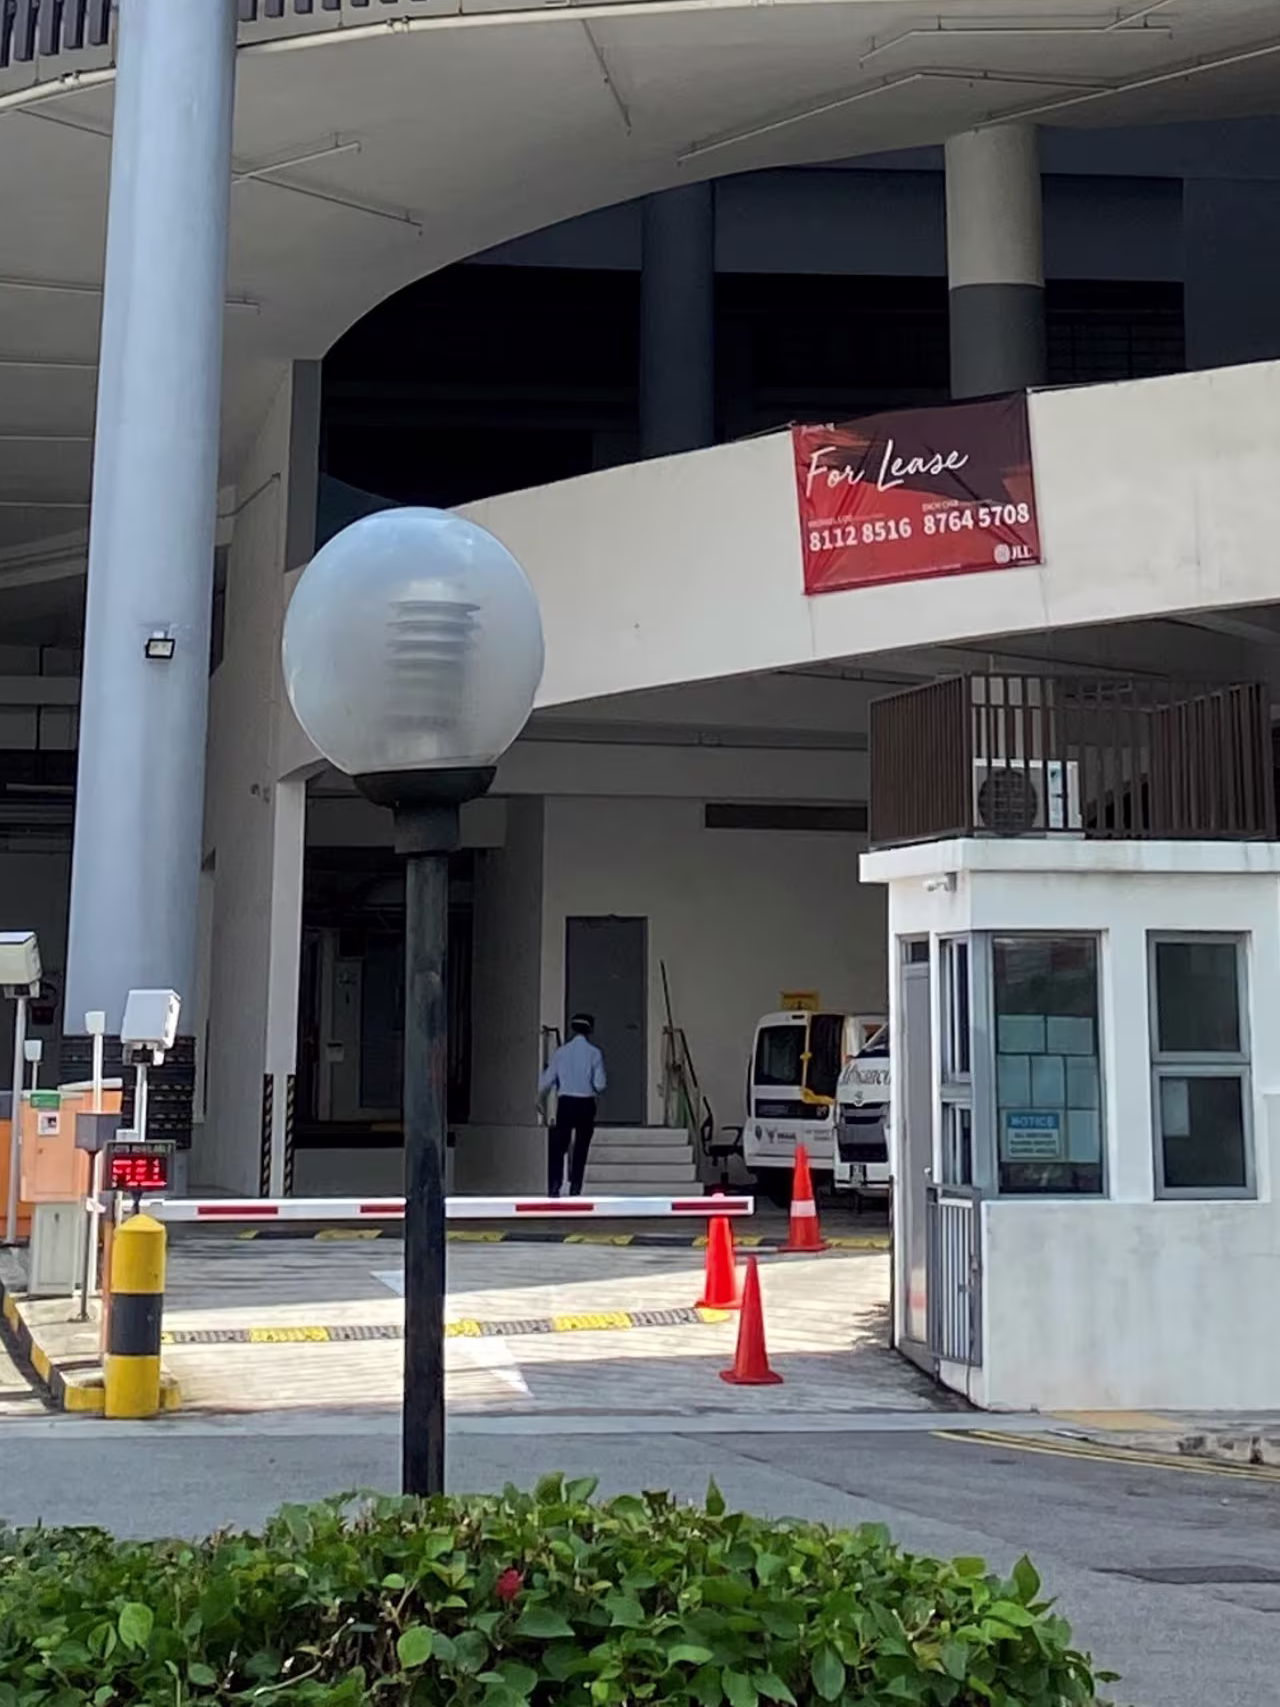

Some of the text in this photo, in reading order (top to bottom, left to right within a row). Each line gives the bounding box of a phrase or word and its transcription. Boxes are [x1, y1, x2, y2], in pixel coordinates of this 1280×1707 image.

[806, 439, 970, 498] For Lease
[809, 526, 858, 552] 8112
[862, 517, 912, 544] 8516
[923, 503, 1030, 535] 8764 5708
[1011, 545, 1032, 560] JLL
[1010, 1115, 1055, 1128] NOTICE
